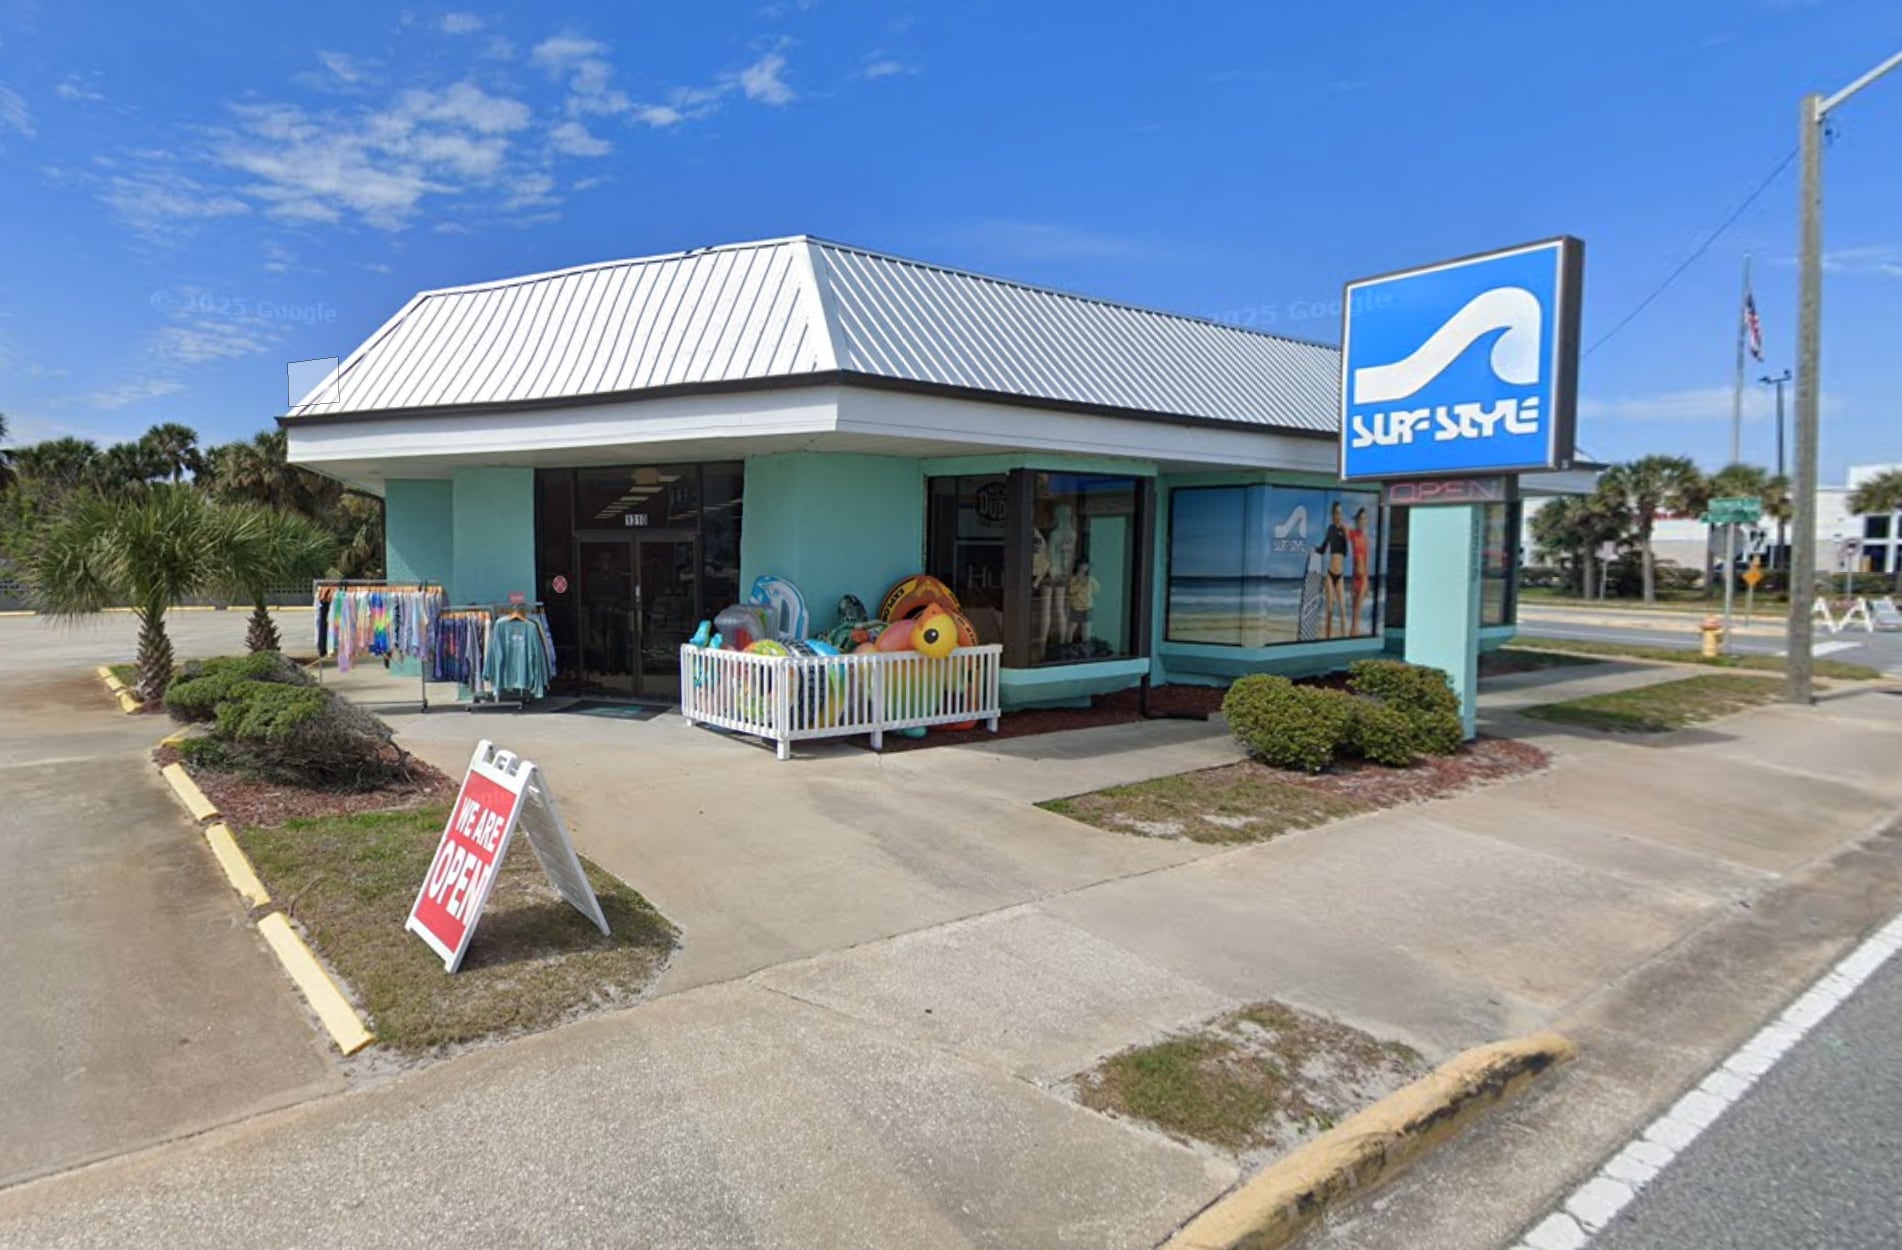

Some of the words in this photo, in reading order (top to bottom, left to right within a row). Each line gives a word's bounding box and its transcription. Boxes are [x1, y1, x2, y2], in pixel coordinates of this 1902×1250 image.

[1351, 407, 1432, 449] SURF
[1434, 395, 1540, 442] STYLE
[1389, 479, 1505, 504] OPEN
[455, 796, 481, 839] WE
[471, 807, 505, 853] ARE
[428, 839, 493, 927] OPEN
